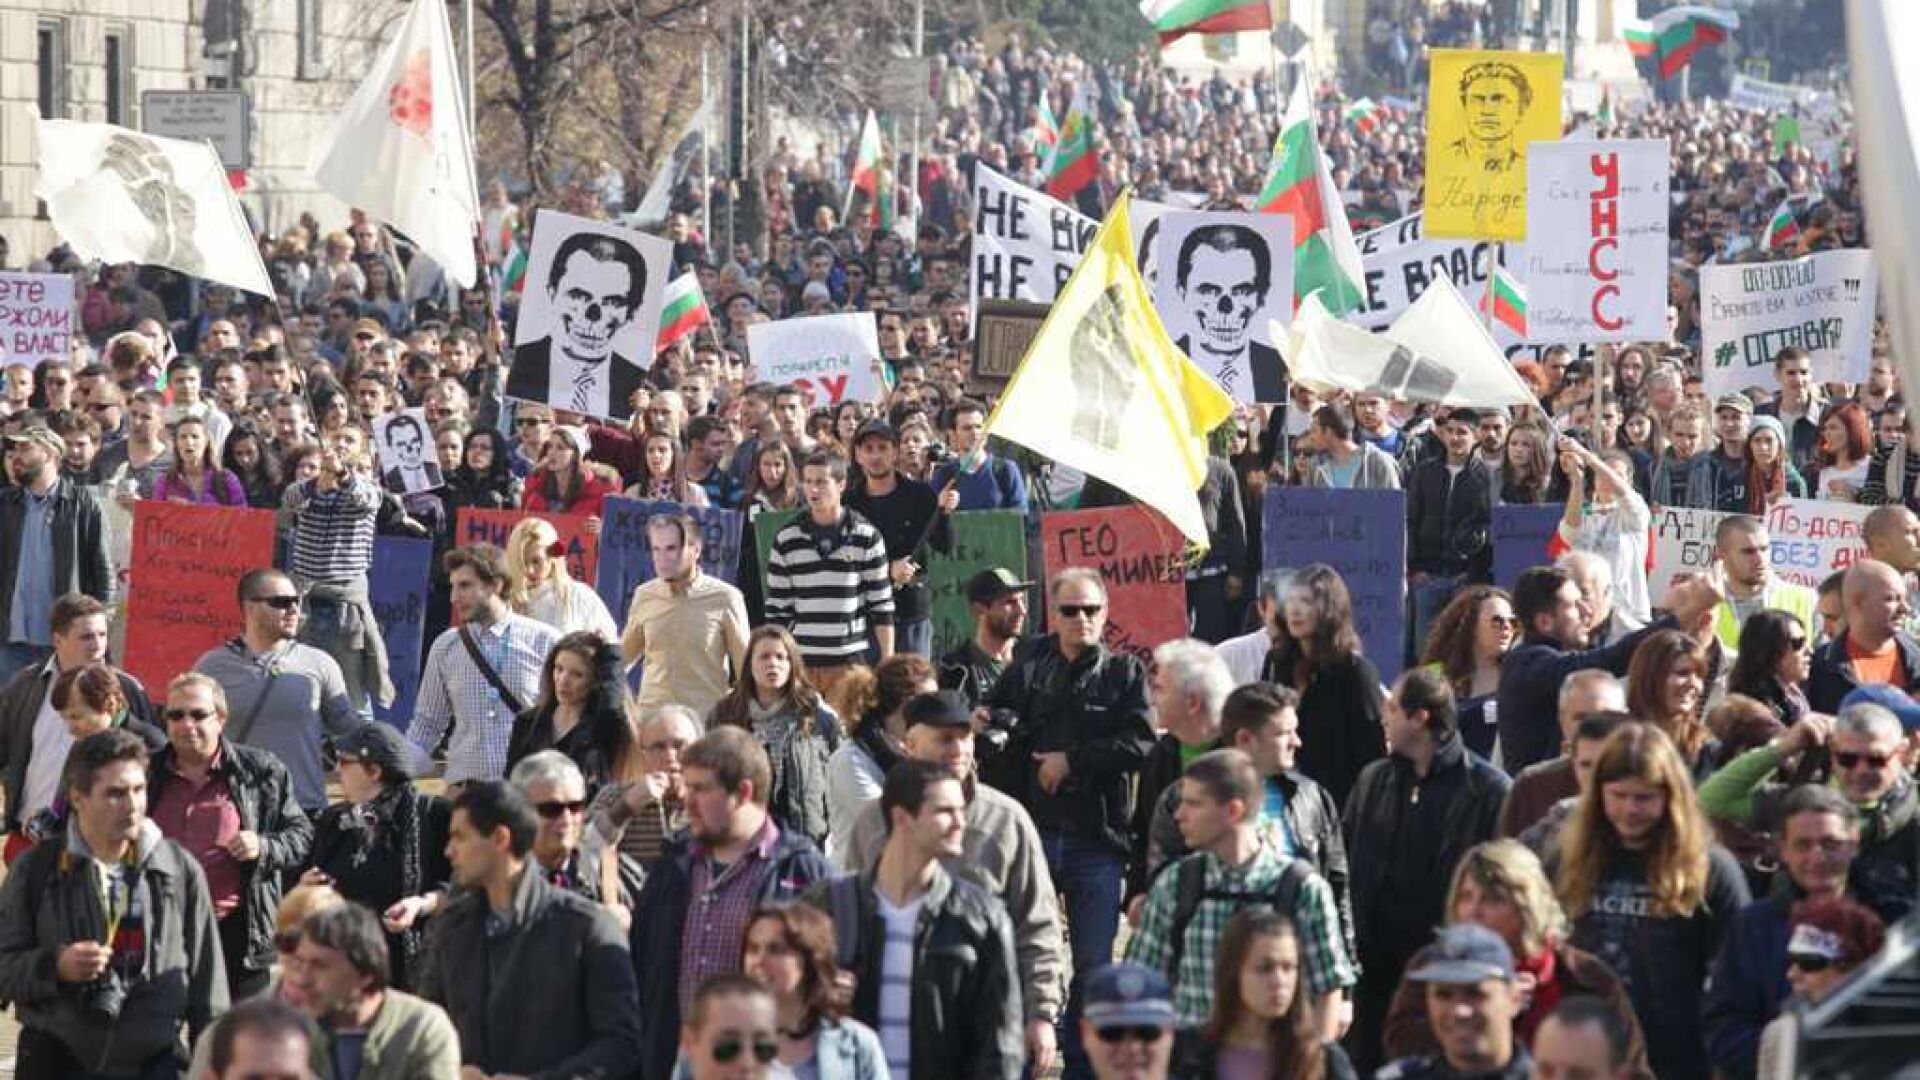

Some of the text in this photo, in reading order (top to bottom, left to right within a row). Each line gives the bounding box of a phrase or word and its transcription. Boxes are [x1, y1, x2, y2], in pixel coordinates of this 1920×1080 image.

[977, 187, 1030, 241] НЕ
[1588, 152, 1623, 331] УНСС
[1058, 523, 1118, 564] ГЕО
[1769, 540, 1820, 568] БЕЗ
